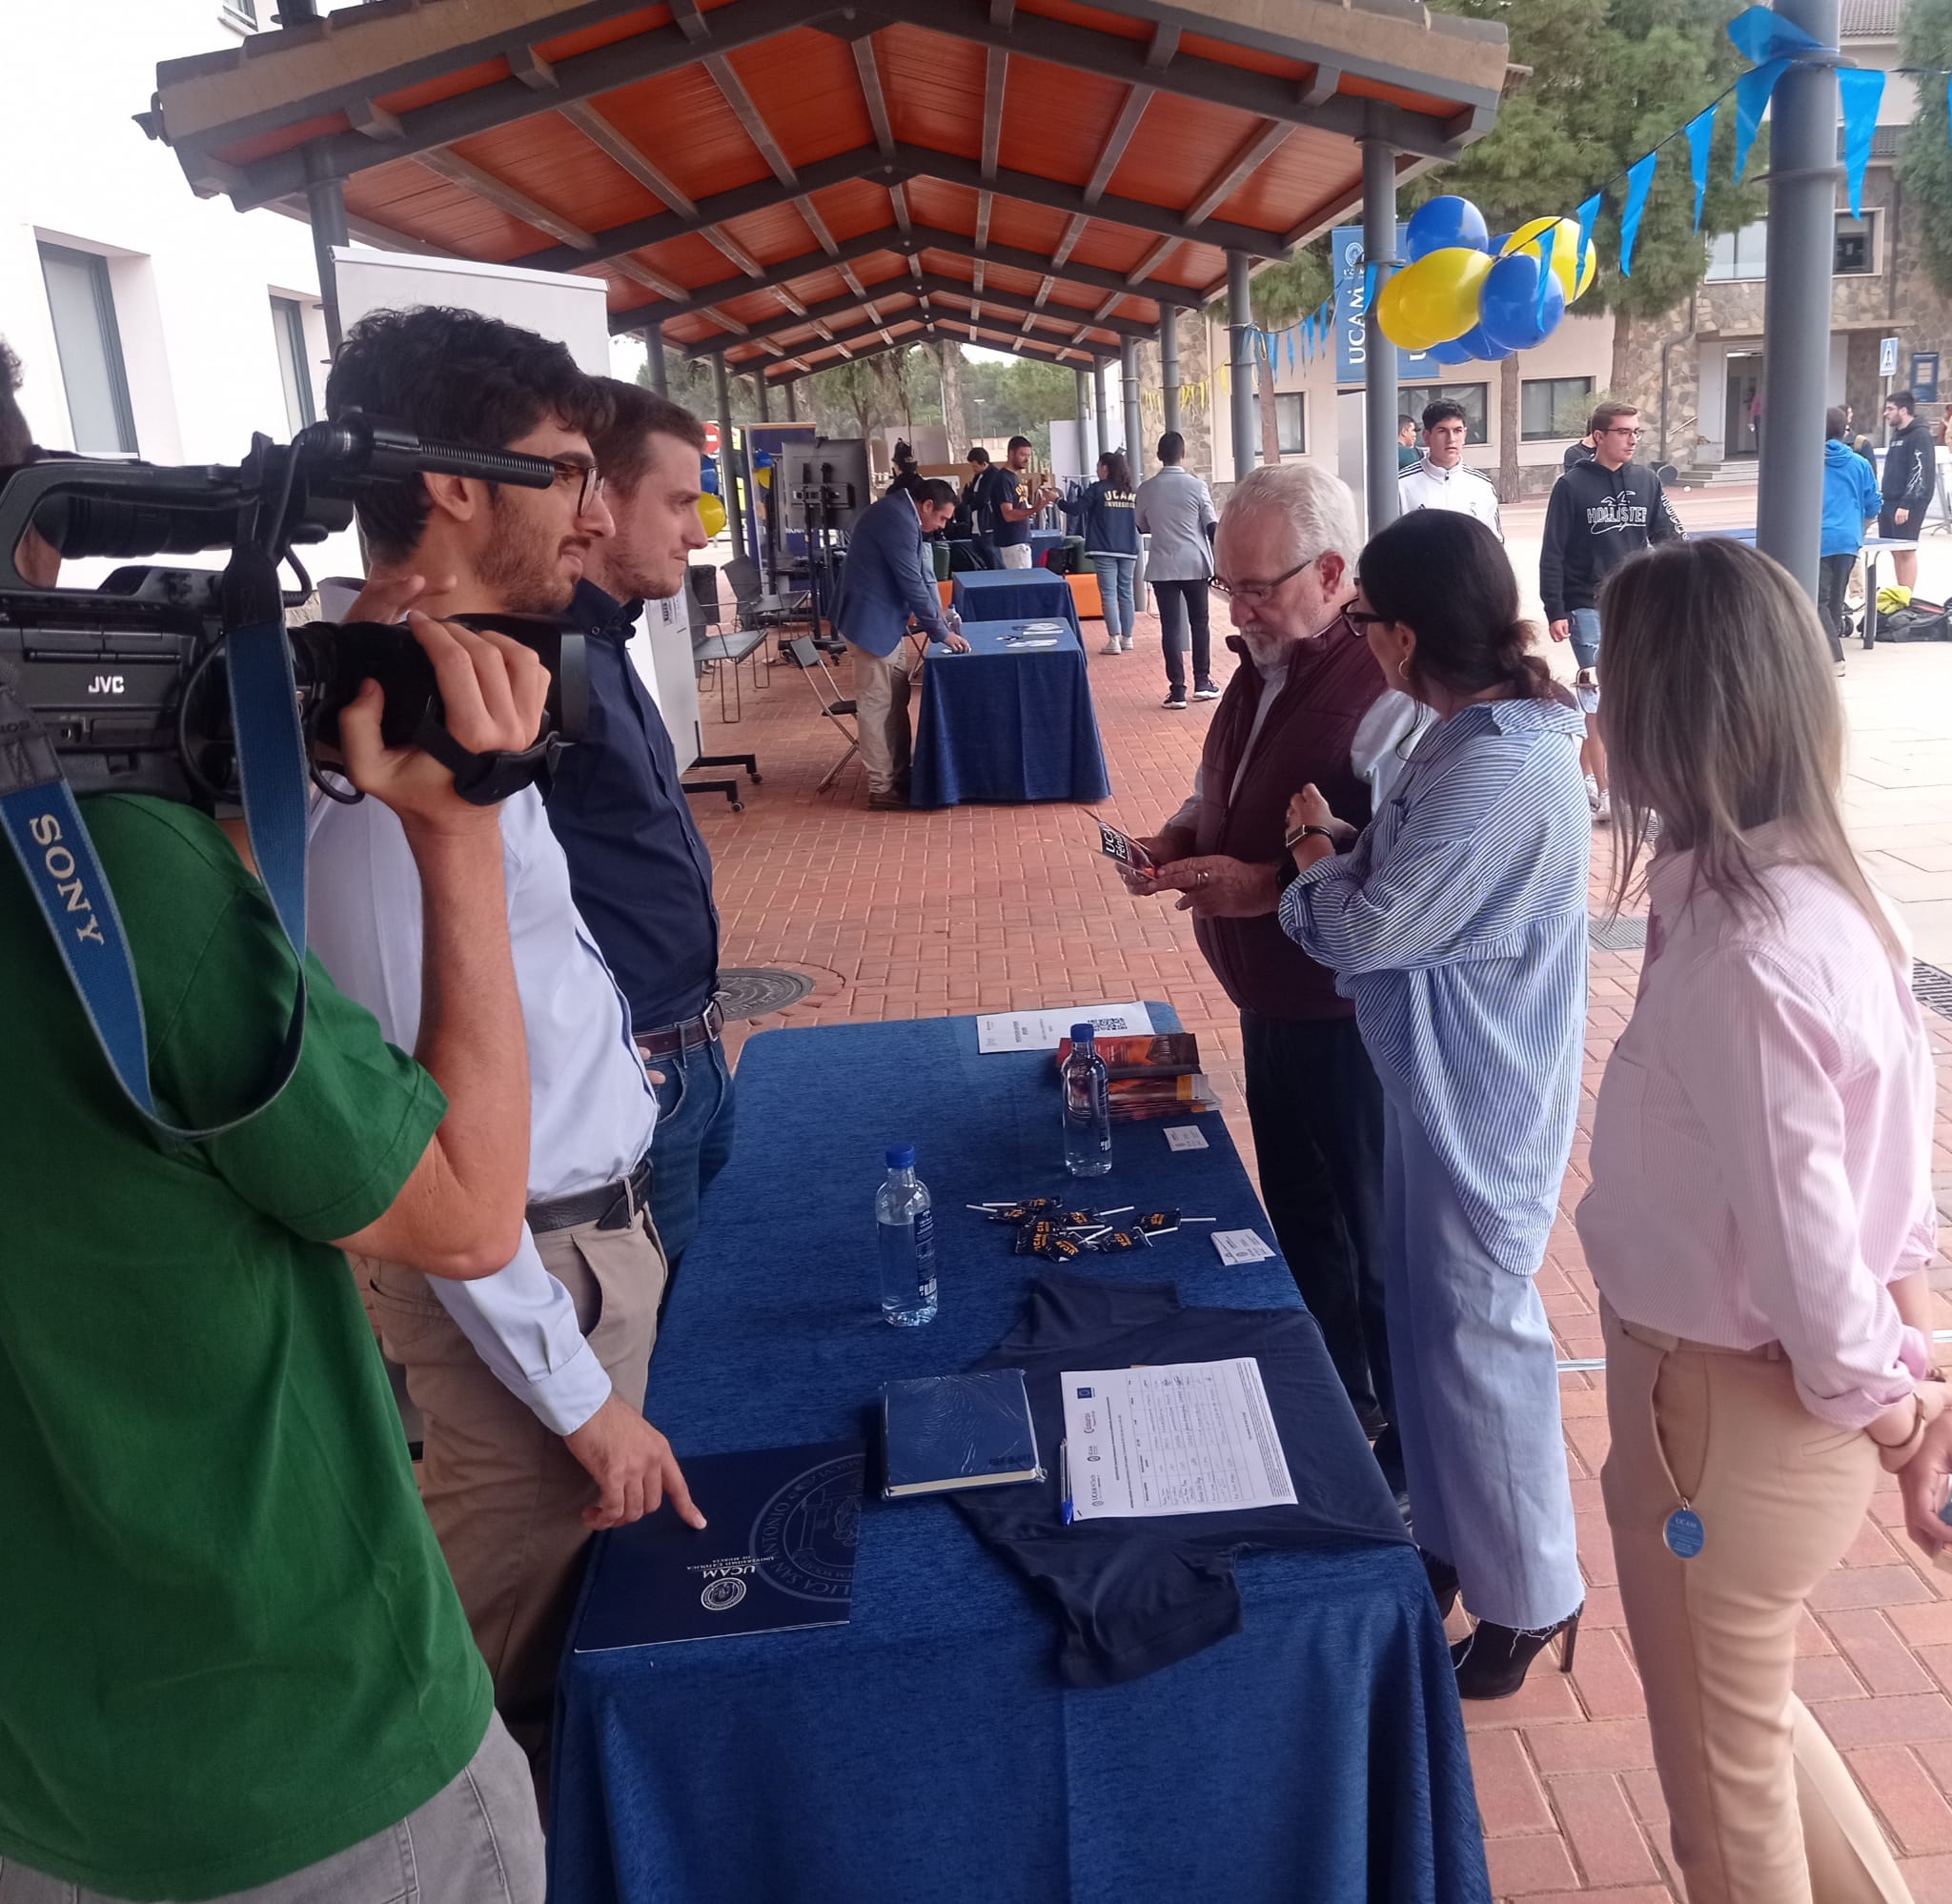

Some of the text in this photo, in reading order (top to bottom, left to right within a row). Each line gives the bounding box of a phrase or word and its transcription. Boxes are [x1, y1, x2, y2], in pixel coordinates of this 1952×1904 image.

[1348, 286, 1366, 364] UCAM
[1104, 490, 1136, 502] UCAM
[1586, 506, 1647, 524] HOLLISTER
[88, 676, 125, 694] JVC
[29, 814, 105, 945] SONY
[702, 1565, 756, 1579] UCAM
